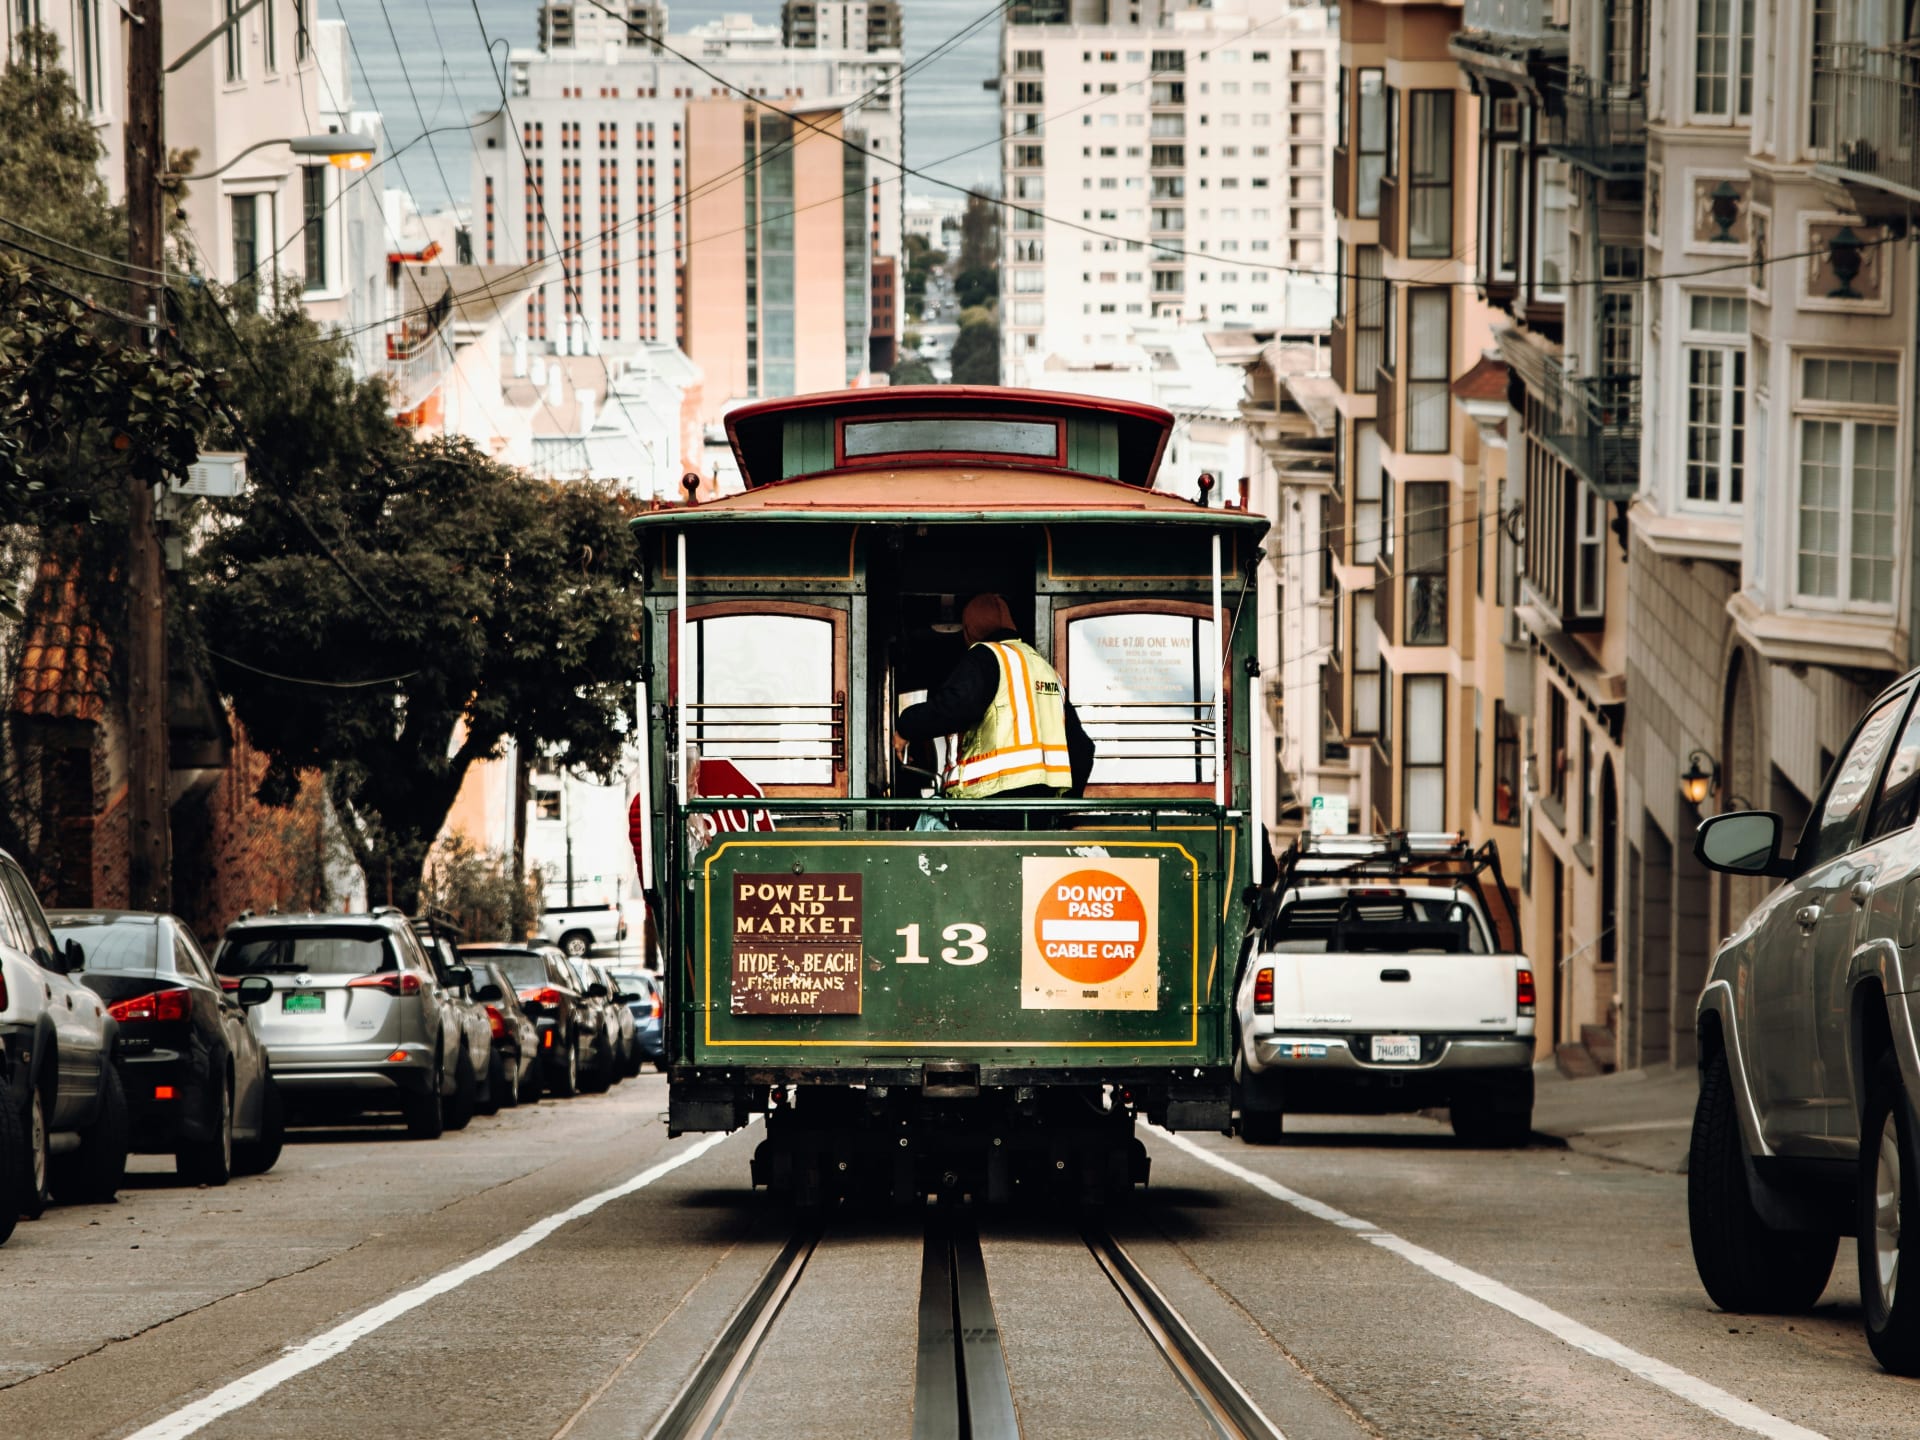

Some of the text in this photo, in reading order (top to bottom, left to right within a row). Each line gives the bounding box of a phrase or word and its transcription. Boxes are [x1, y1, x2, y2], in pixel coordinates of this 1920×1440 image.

[1147, 636, 1168, 648] ONE
[1171, 636, 1192, 648] WAY
[1035, 680, 1060, 693] SFMTA
[740, 884, 854, 901] POWELL
[1058, 885, 1126, 902] DO NOT
[769, 902, 825, 915] AND
[1068, 902, 1115, 918] PASS
[737, 917, 856, 934] MARKET
[895, 923, 989, 966] 13
[1045, 943, 1136, 959] CABLE CAR
[738, 953, 779, 972] HYDE
[803, 953, 854, 972] BEACH
[747, 976, 844, 990] FISHERMANS
[771, 991, 820, 1005] WHARF
